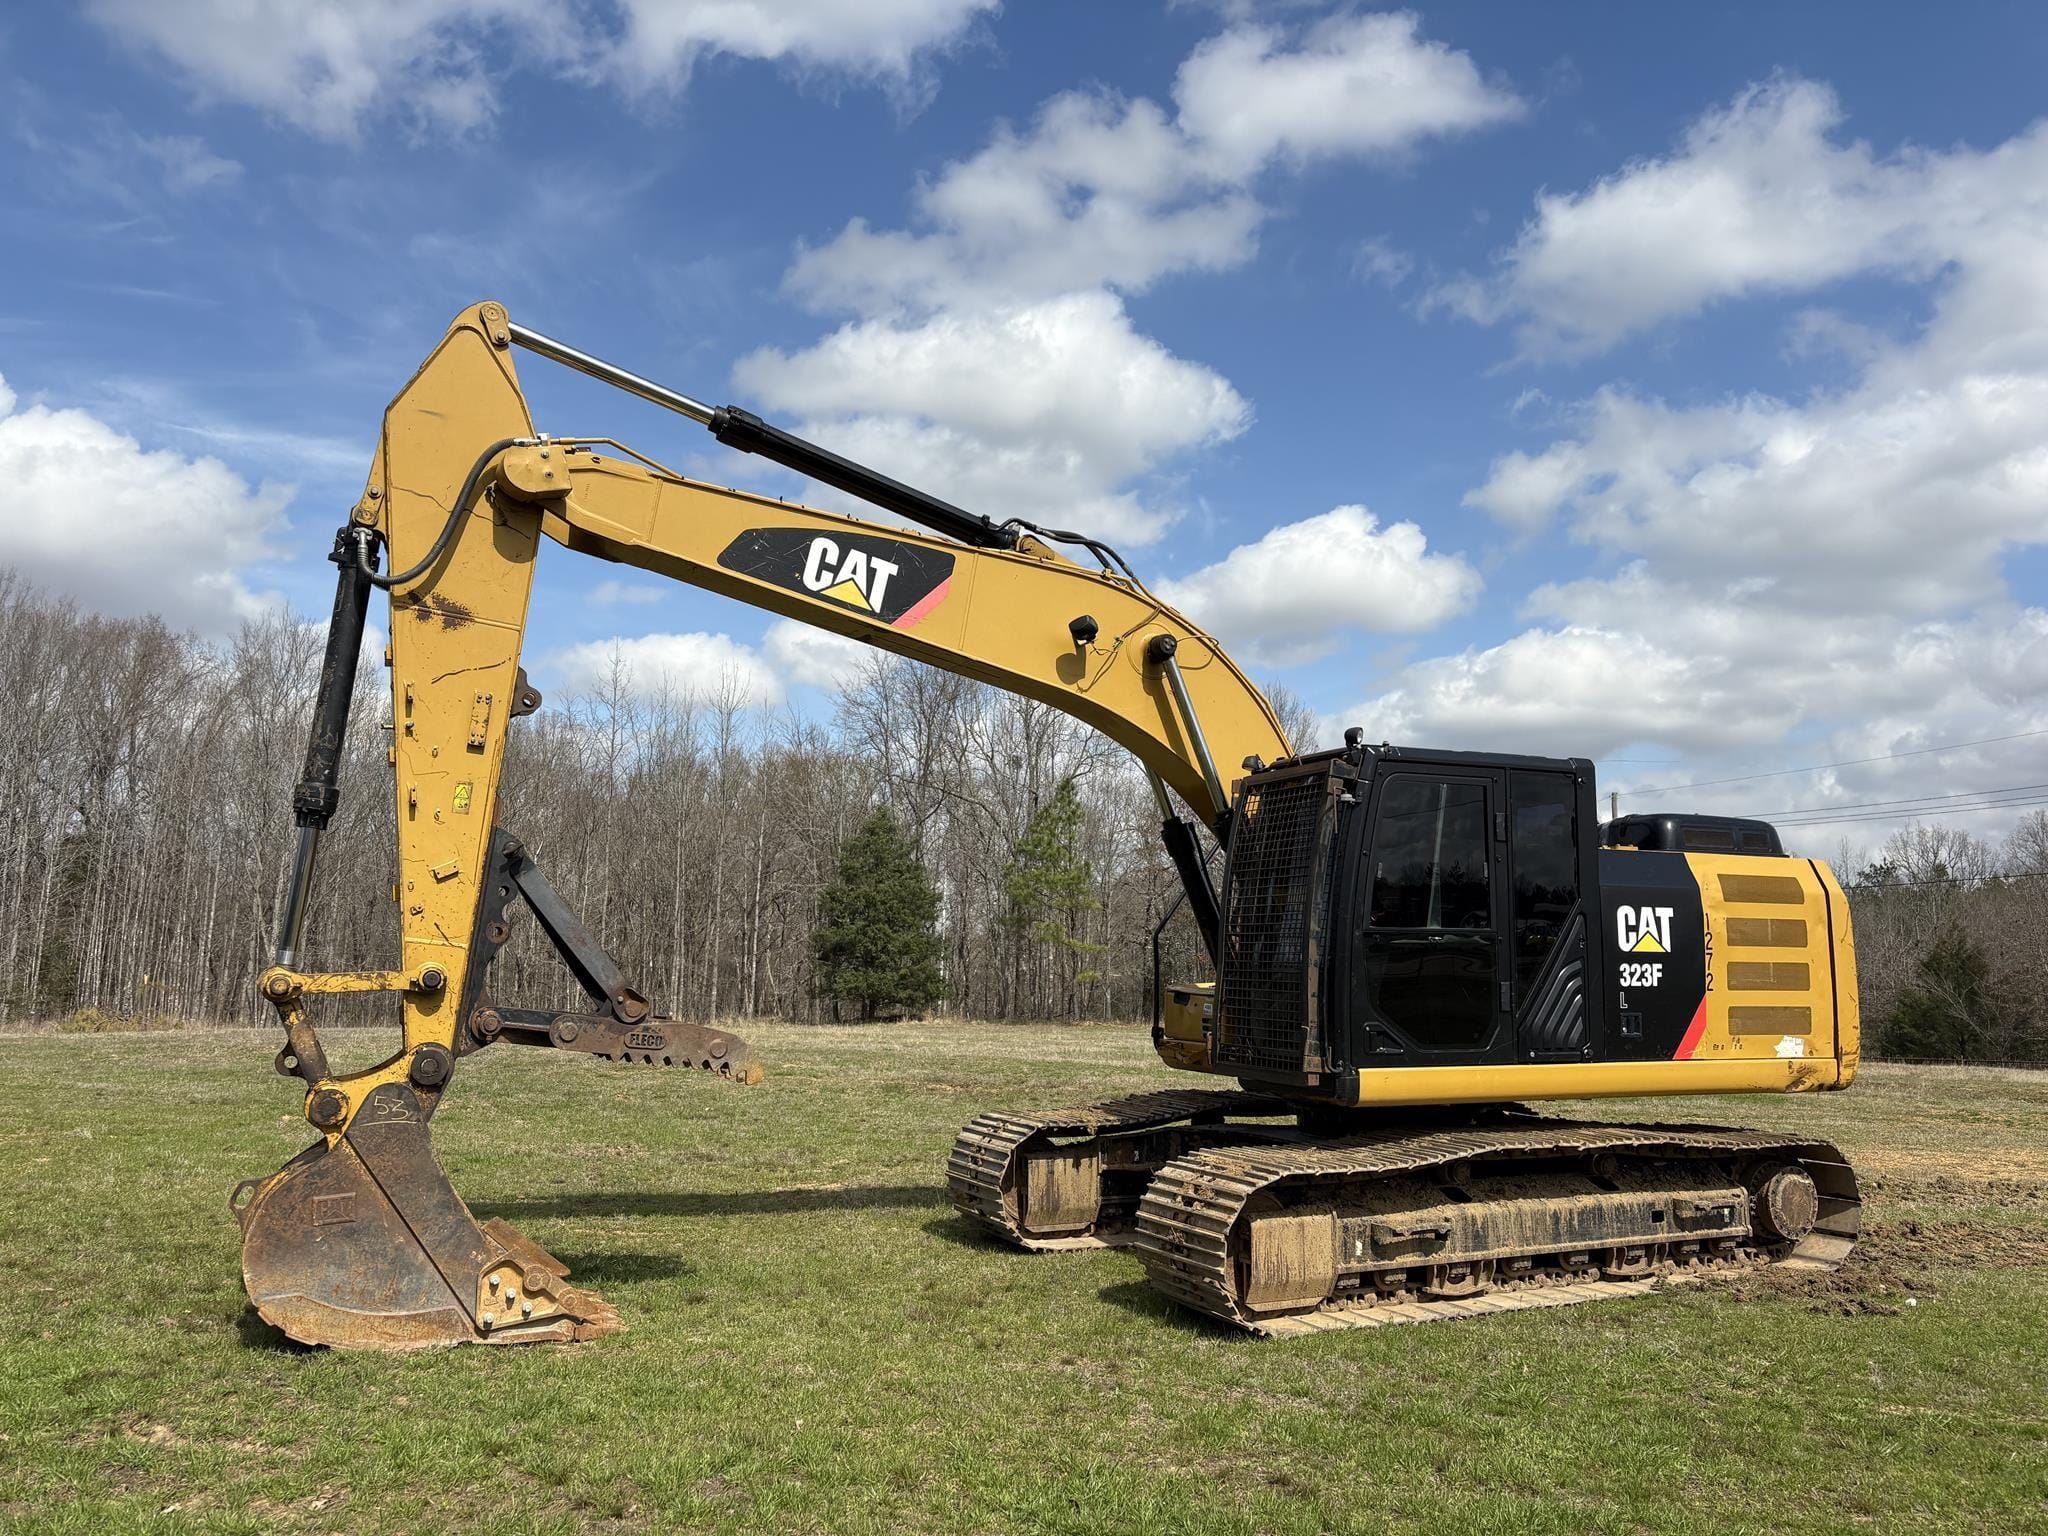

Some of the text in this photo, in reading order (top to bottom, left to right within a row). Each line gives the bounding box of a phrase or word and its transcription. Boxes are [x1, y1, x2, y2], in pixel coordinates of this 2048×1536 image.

[804, 537, 899, 614] CAT
[1617, 905, 1674, 952] CAT
[1619, 963, 1663, 987] 323F
[1620, 992, 1628, 1008] L
[374, 1095, 409, 1120] 53
